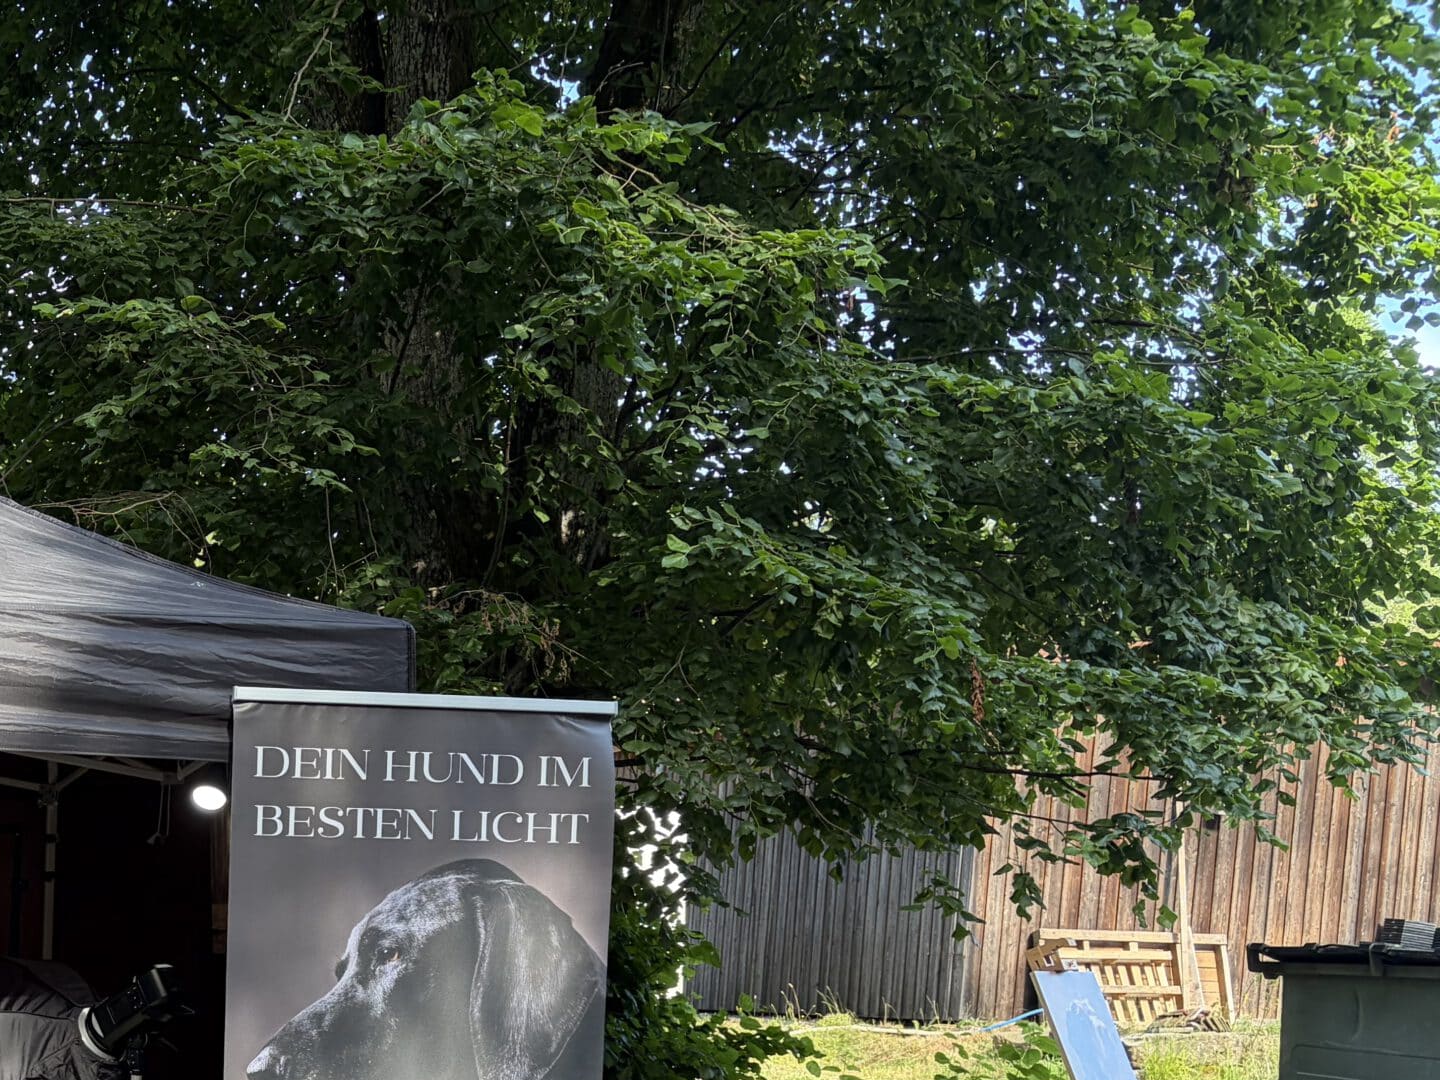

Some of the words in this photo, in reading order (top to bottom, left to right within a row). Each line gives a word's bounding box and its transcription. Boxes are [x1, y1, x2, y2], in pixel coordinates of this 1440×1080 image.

[253, 745, 371, 781] DEIN
[382, 750, 524, 785] HUND
[537, 755, 592, 788] IM
[254, 804, 438, 841] BESTEN
[450, 810, 590, 845] LICHT
